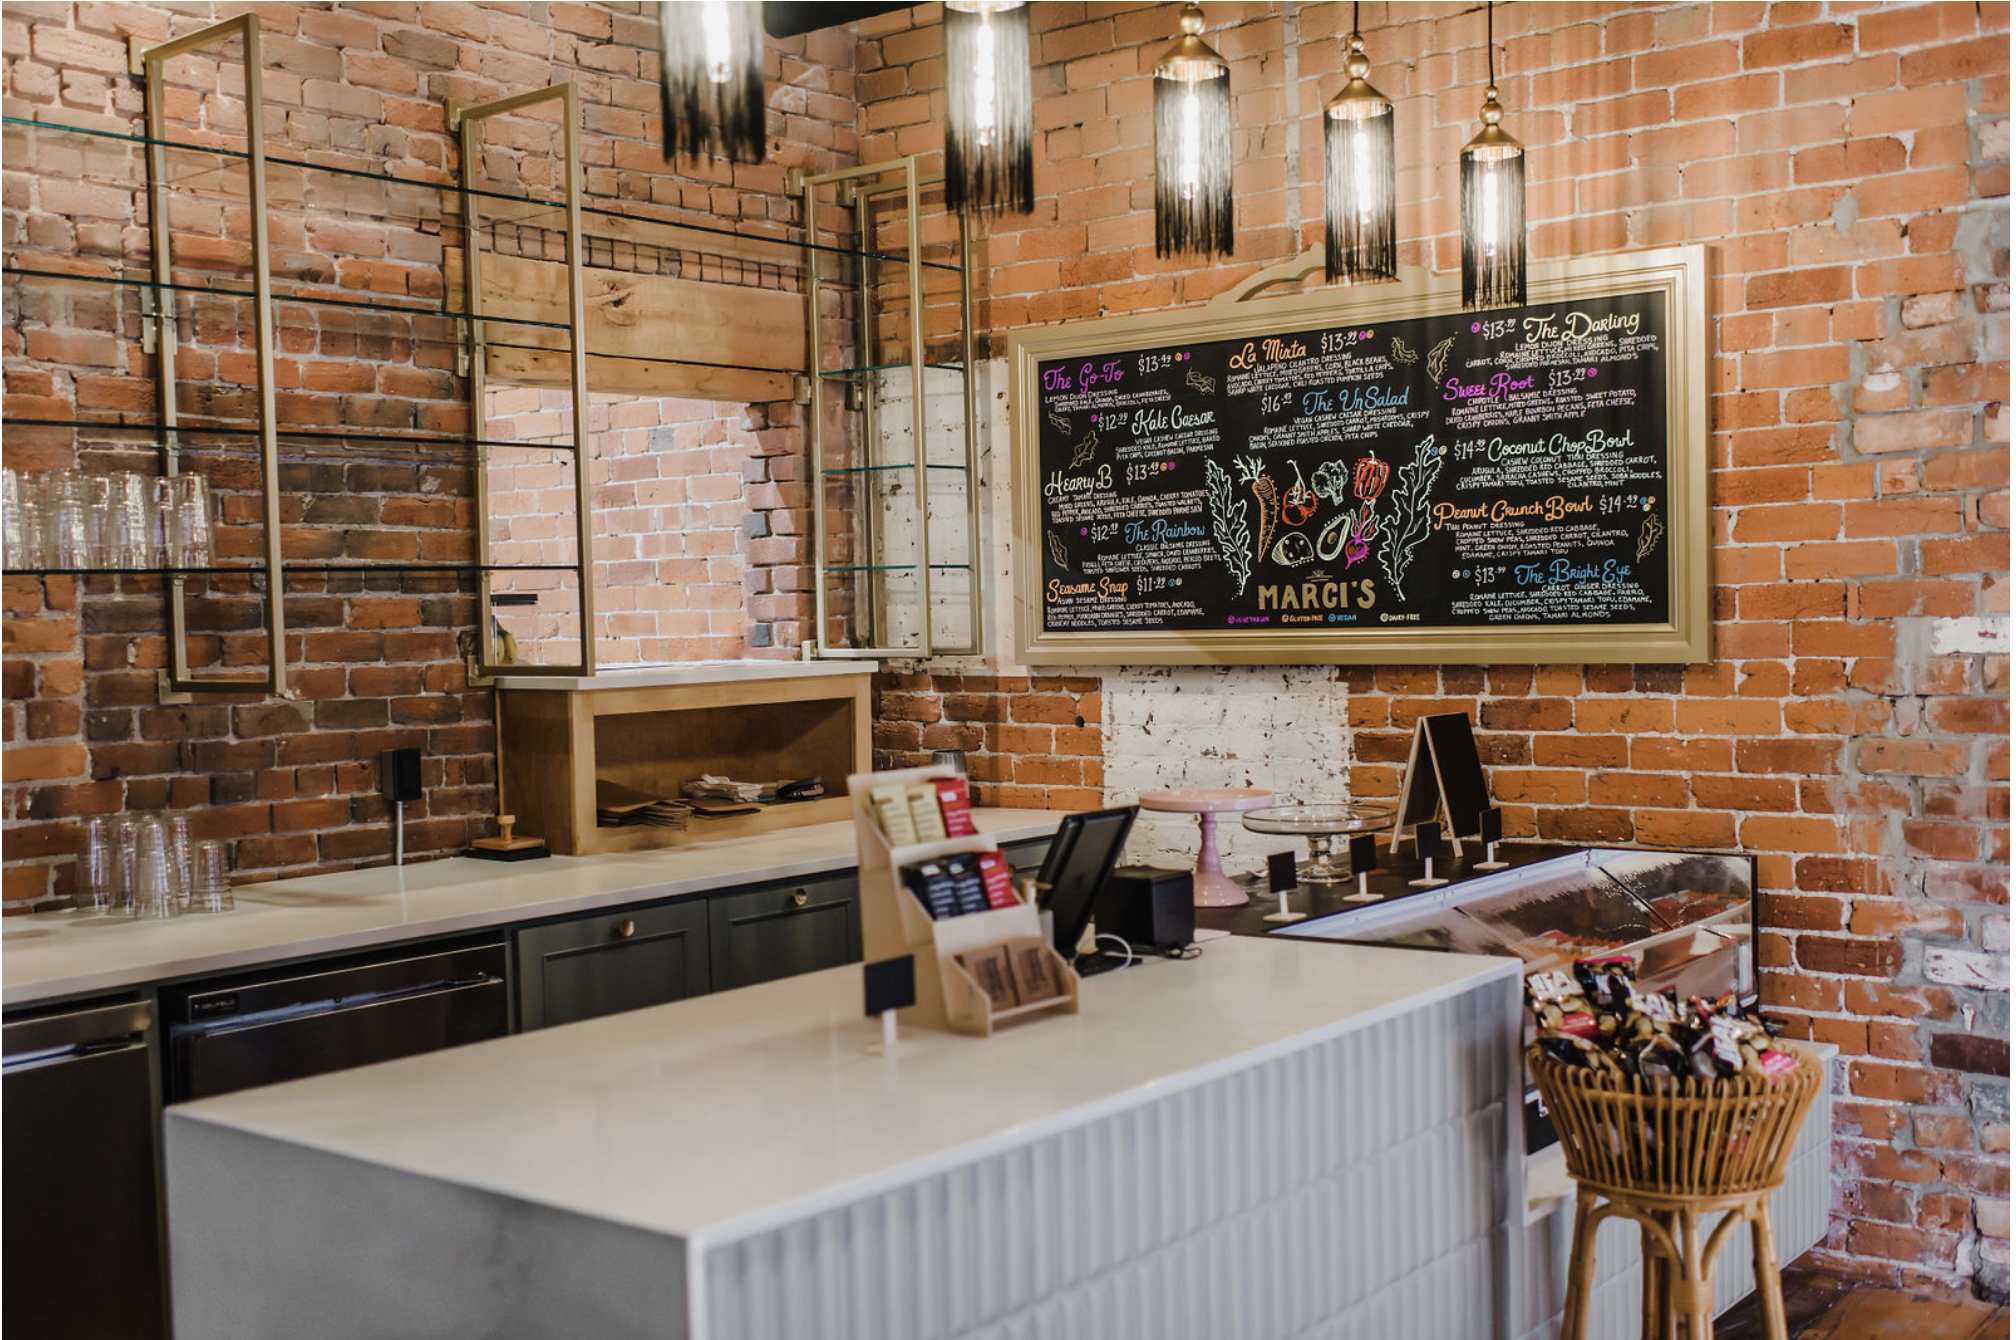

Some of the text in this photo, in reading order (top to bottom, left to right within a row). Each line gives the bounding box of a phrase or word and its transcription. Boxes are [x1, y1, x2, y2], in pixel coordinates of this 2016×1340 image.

[1523, 313, 1558, 343] The
[1561, 312, 1640, 341] Darling
[1566, 333, 1610, 347] DRESSING
[1229, 331, 1358, 370] La Mixta $13.99
[1043, 366, 1072, 391] The
[1079, 359, 1125, 394] Go-To
[1443, 377, 1487, 401] Sweet
[1488, 372, 1535, 402] Root
[1302, 389, 1333, 415] The
[1542, 387, 1578, 398] DRESSING
[1131, 408, 1170, 437] Kale
[1171, 404, 1216, 429] Caesar
[1488, 437, 1546, 462] Coconut
[1500, 457, 1528, 467] CASHEW
[1585, 450, 1625, 461] DRESSING
[1095, 463, 1113, 490] B
[1126, 462, 1160, 486] $13.49
[1433, 494, 1639, 531] Peanut Crunch Bowl $14.49
[1490, 520, 1525, 530] DRESSING
[1124, 519, 1150, 544] The
[1150, 518, 1205, 545] Rainbow
[1474, 558, 1632, 588] $13.99 The Bright Eye
[1601, 581, 1640, 590] DRESSING
[1046, 578, 1097, 603] Seasame
[1097, 576, 1128, 600] Snap
[1258, 579, 1376, 611] MARCI'S
[1570, 610, 1611, 619] ALMONDS
